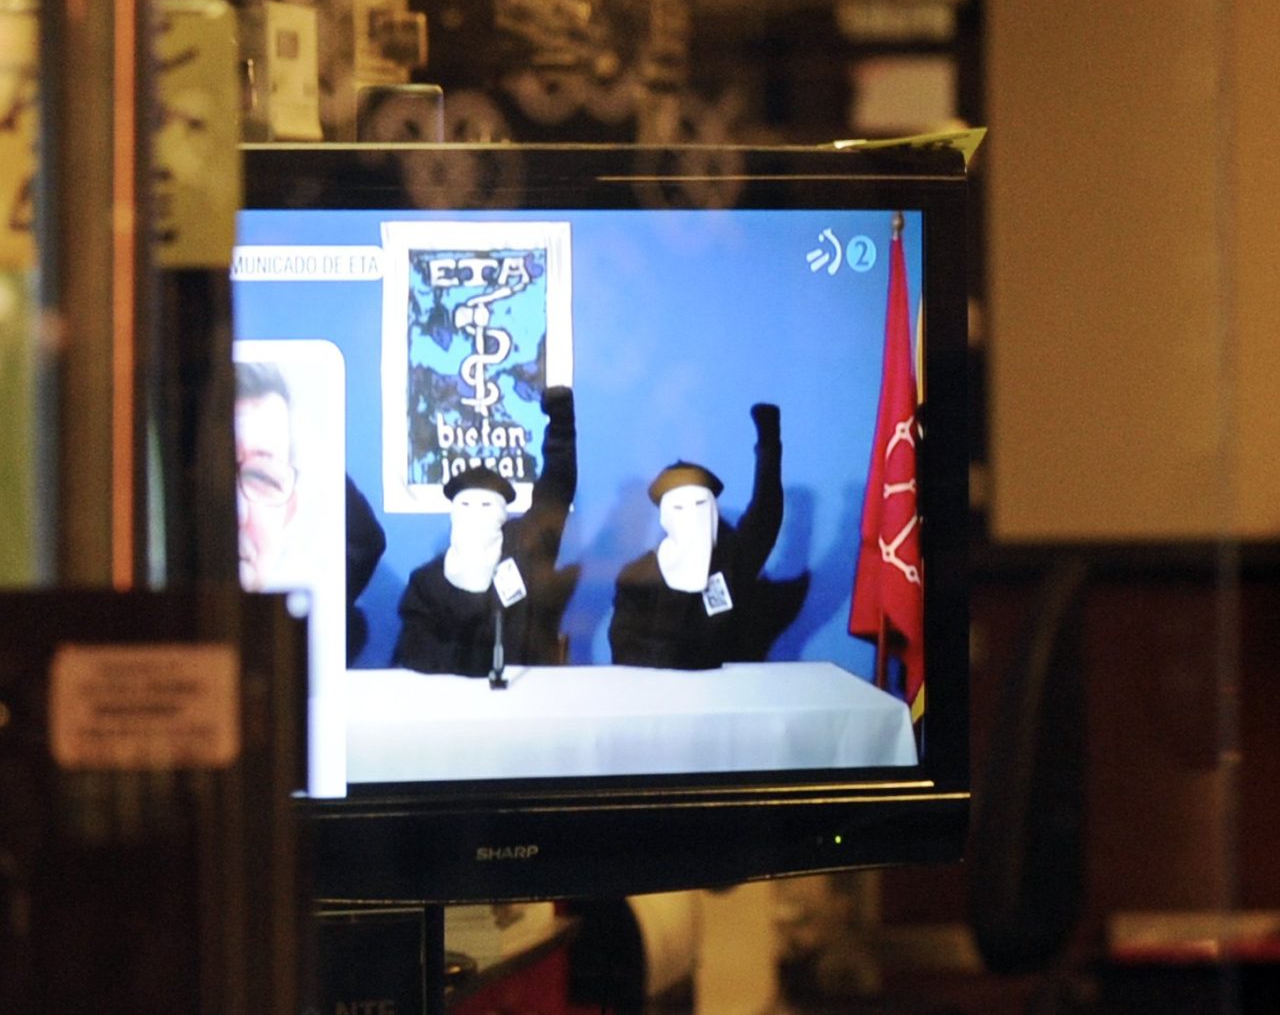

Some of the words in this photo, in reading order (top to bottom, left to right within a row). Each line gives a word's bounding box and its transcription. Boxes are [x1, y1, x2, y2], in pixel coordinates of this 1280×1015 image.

[323, 256, 342, 274] DE
[349, 255, 379, 274] ETA
[429, 257, 531, 286] ETA
[436, 413, 526, 448] bietan
[476, 845, 539, 860] SHARP
